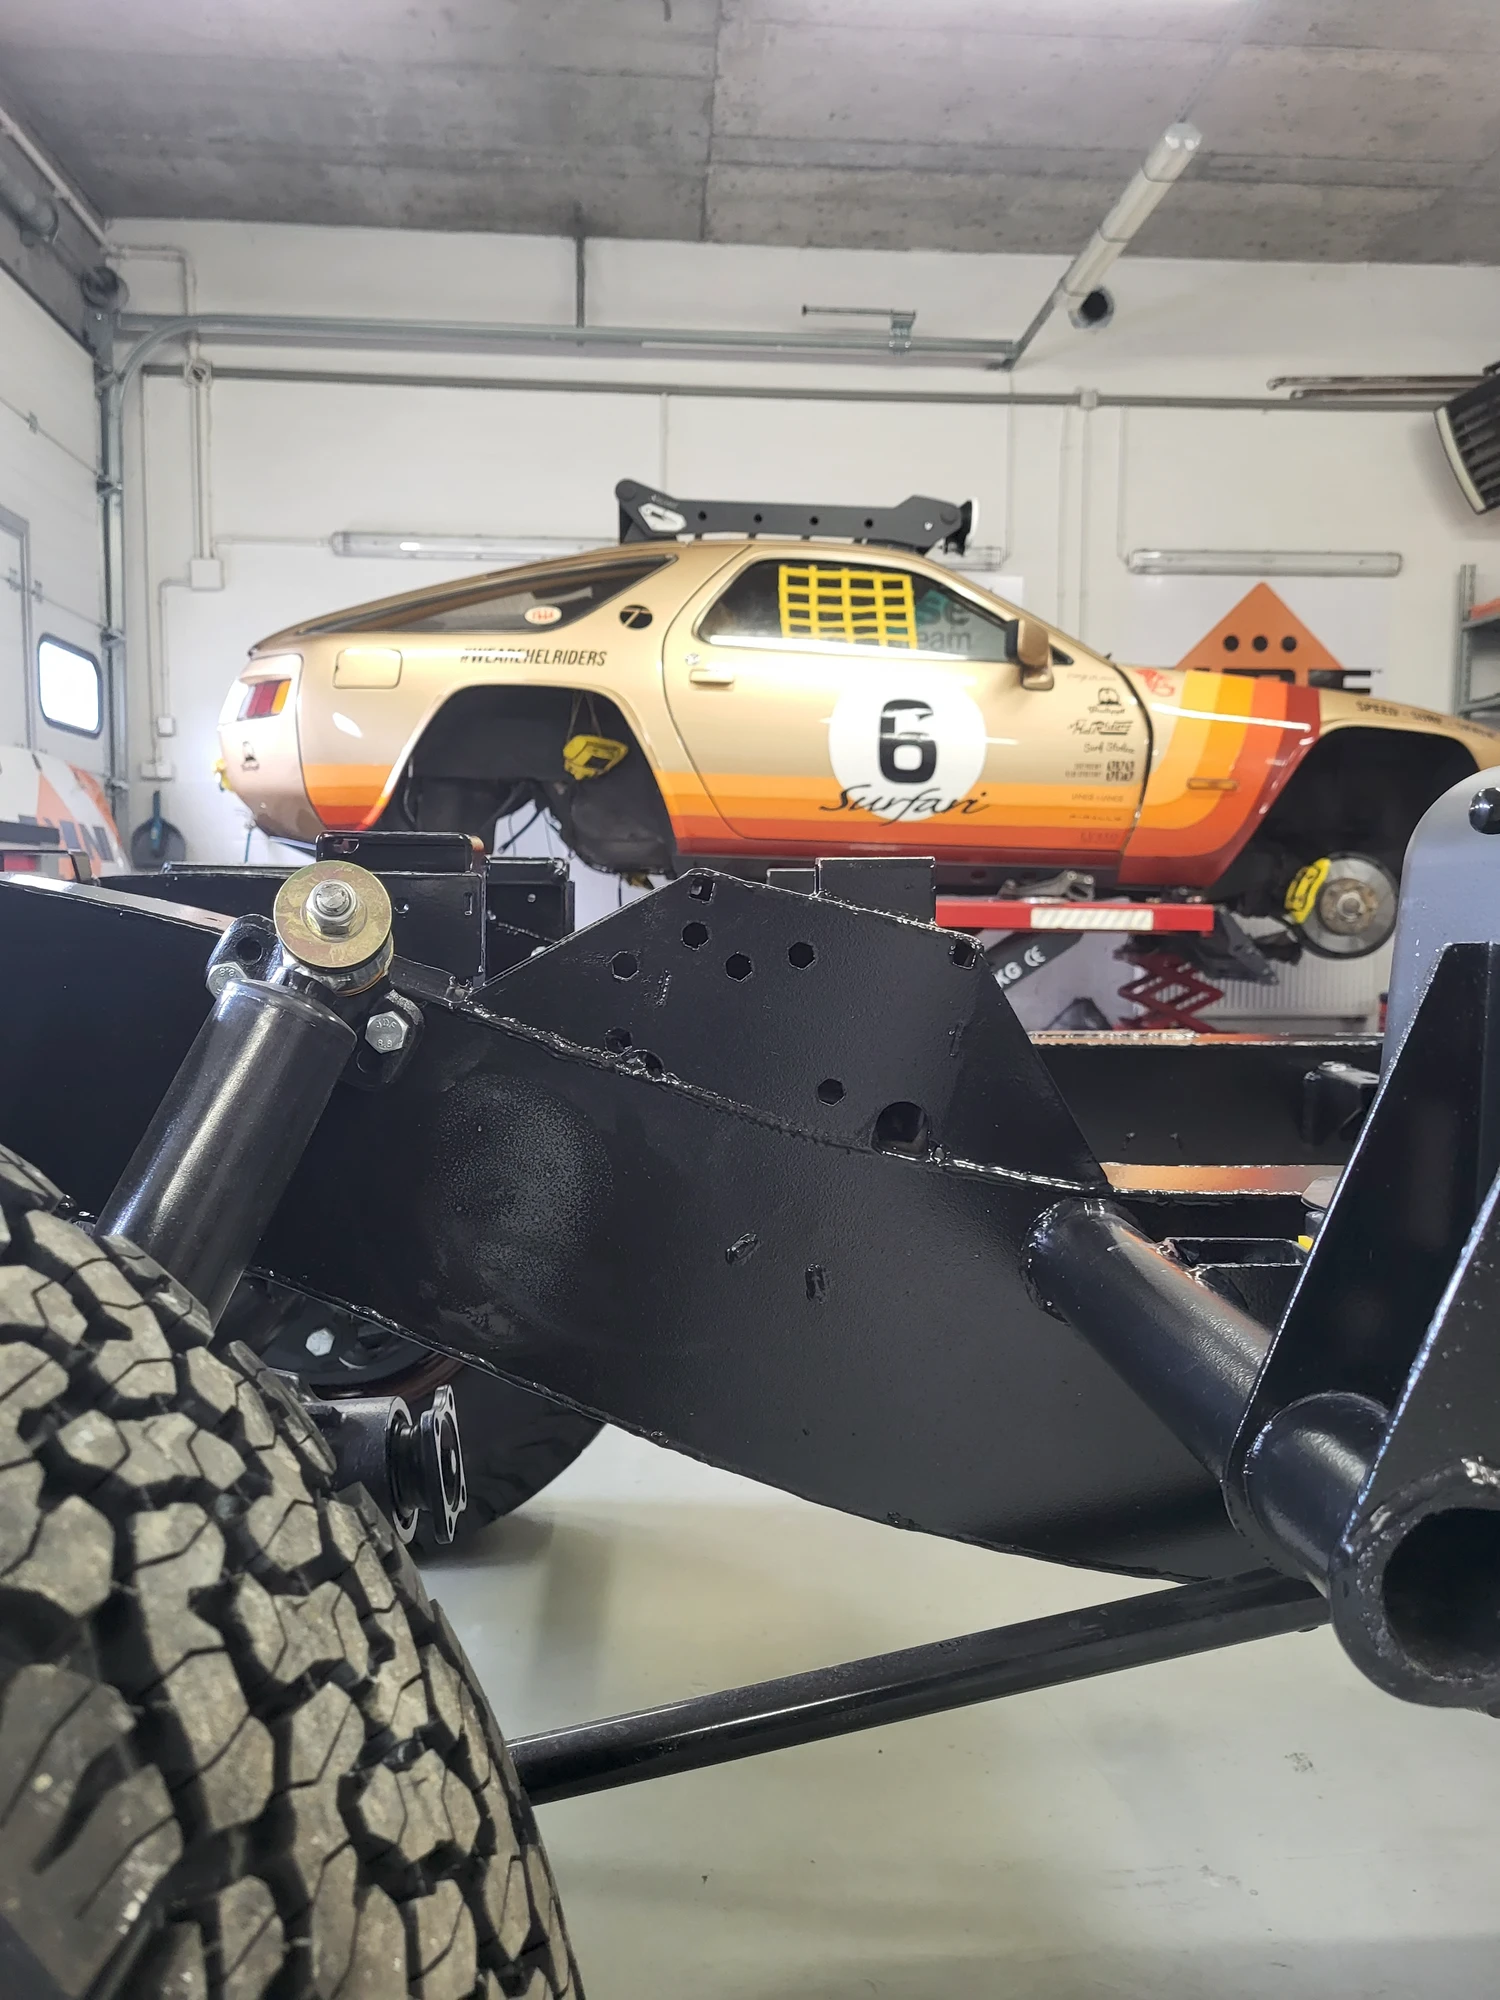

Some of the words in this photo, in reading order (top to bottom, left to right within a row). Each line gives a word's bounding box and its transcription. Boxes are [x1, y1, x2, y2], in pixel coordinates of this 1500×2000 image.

[917, 630, 972, 652] eam
[878, 699, 938, 784] 6
[818, 784, 990, 827] Surfari
[377, 1038, 393, 1048] 8.8
